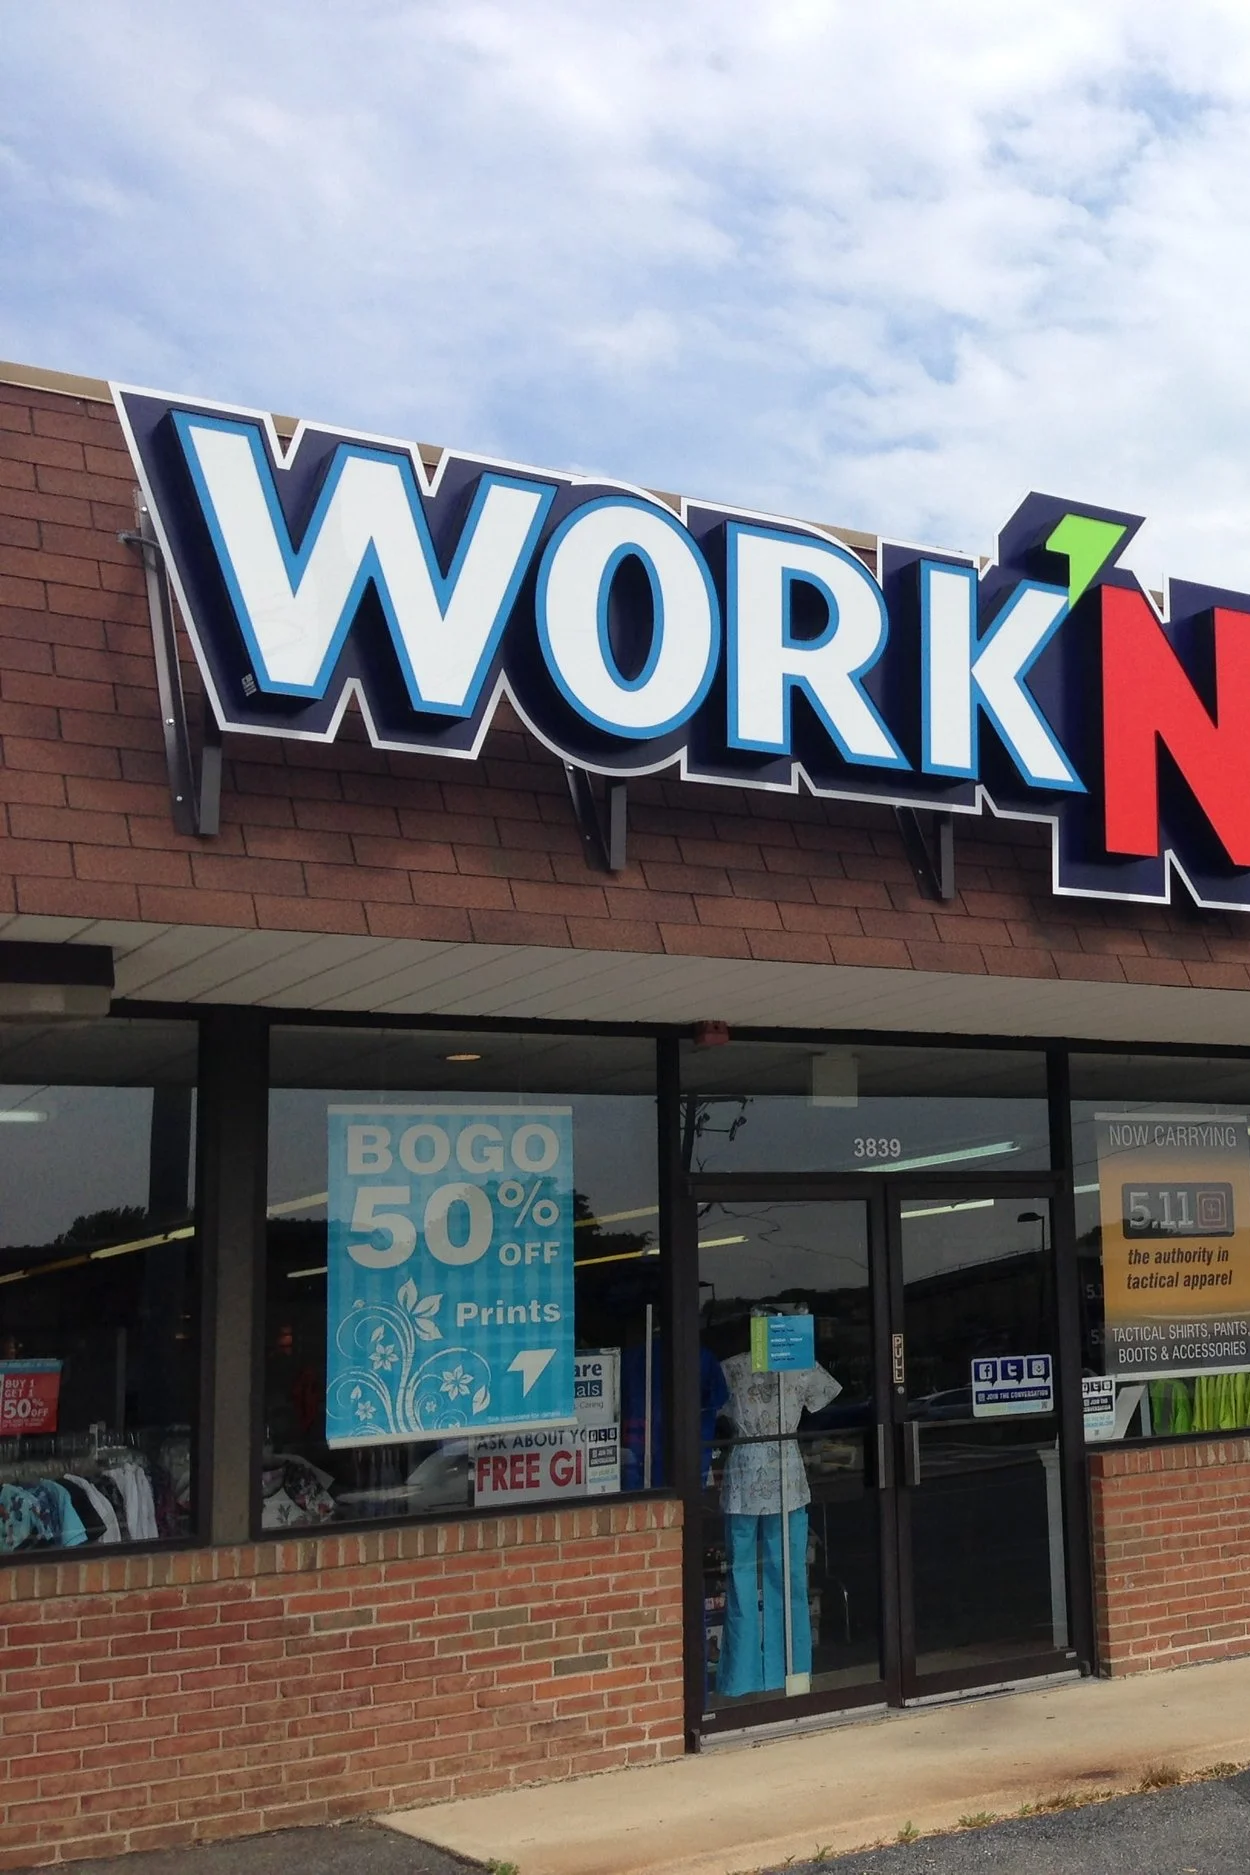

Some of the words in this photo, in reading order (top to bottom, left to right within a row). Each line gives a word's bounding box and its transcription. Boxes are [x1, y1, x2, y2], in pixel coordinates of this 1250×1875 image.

[1109, 1124, 1149, 1147] NOW
[1154, 1125, 1237, 1148] CARRYING
[347, 1123, 560, 1176] BOGO
[853, 1138, 901, 1158] 3839
[1128, 1191, 1194, 1230] 5.11
[346, 1180, 560, 1269] 50%
[499, 1241, 561, 1267] OFF
[1127, 1248, 1150, 1266] the
[1154, 1247, 1214, 1268] authority
[1216, 1246, 1230, 1263] in
[1126, 1272, 1179, 1291] tactical
[1182, 1270, 1233, 1291] apparel
[456, 1299, 561, 1328] Prints
[1111, 1325, 1166, 1343] TACTICAL
[1168, 1322, 1212, 1340] SHIRTS,
[1213, 1320, 1250, 1338] PANTS,
[893, 1335, 903, 1381] PULL
[1118, 1346, 1158, 1364] BOOTS
[1160, 1345, 1169, 1361] &
[1171, 1340, 1247, 1360] ACCESSORIES
[574, 1362, 603, 1378] are
[4, 1389, 24, 1398] GET
[28, 1388, 34, 1398] 1
[5, 1379, 27, 1389] BUY
[29, 1379, 35, 1389] 1
[575, 1384, 602, 1397] als
[986, 1393, 999, 1401] JOIN
[1010, 1389, 1049, 1399] CONVERSATION
[31, 1408, 49, 1417] OFF
[512, 1430, 565, 1450] ABOUT
[477, 1452, 541, 1493] FREE
[549, 1449, 587, 1488] GI
